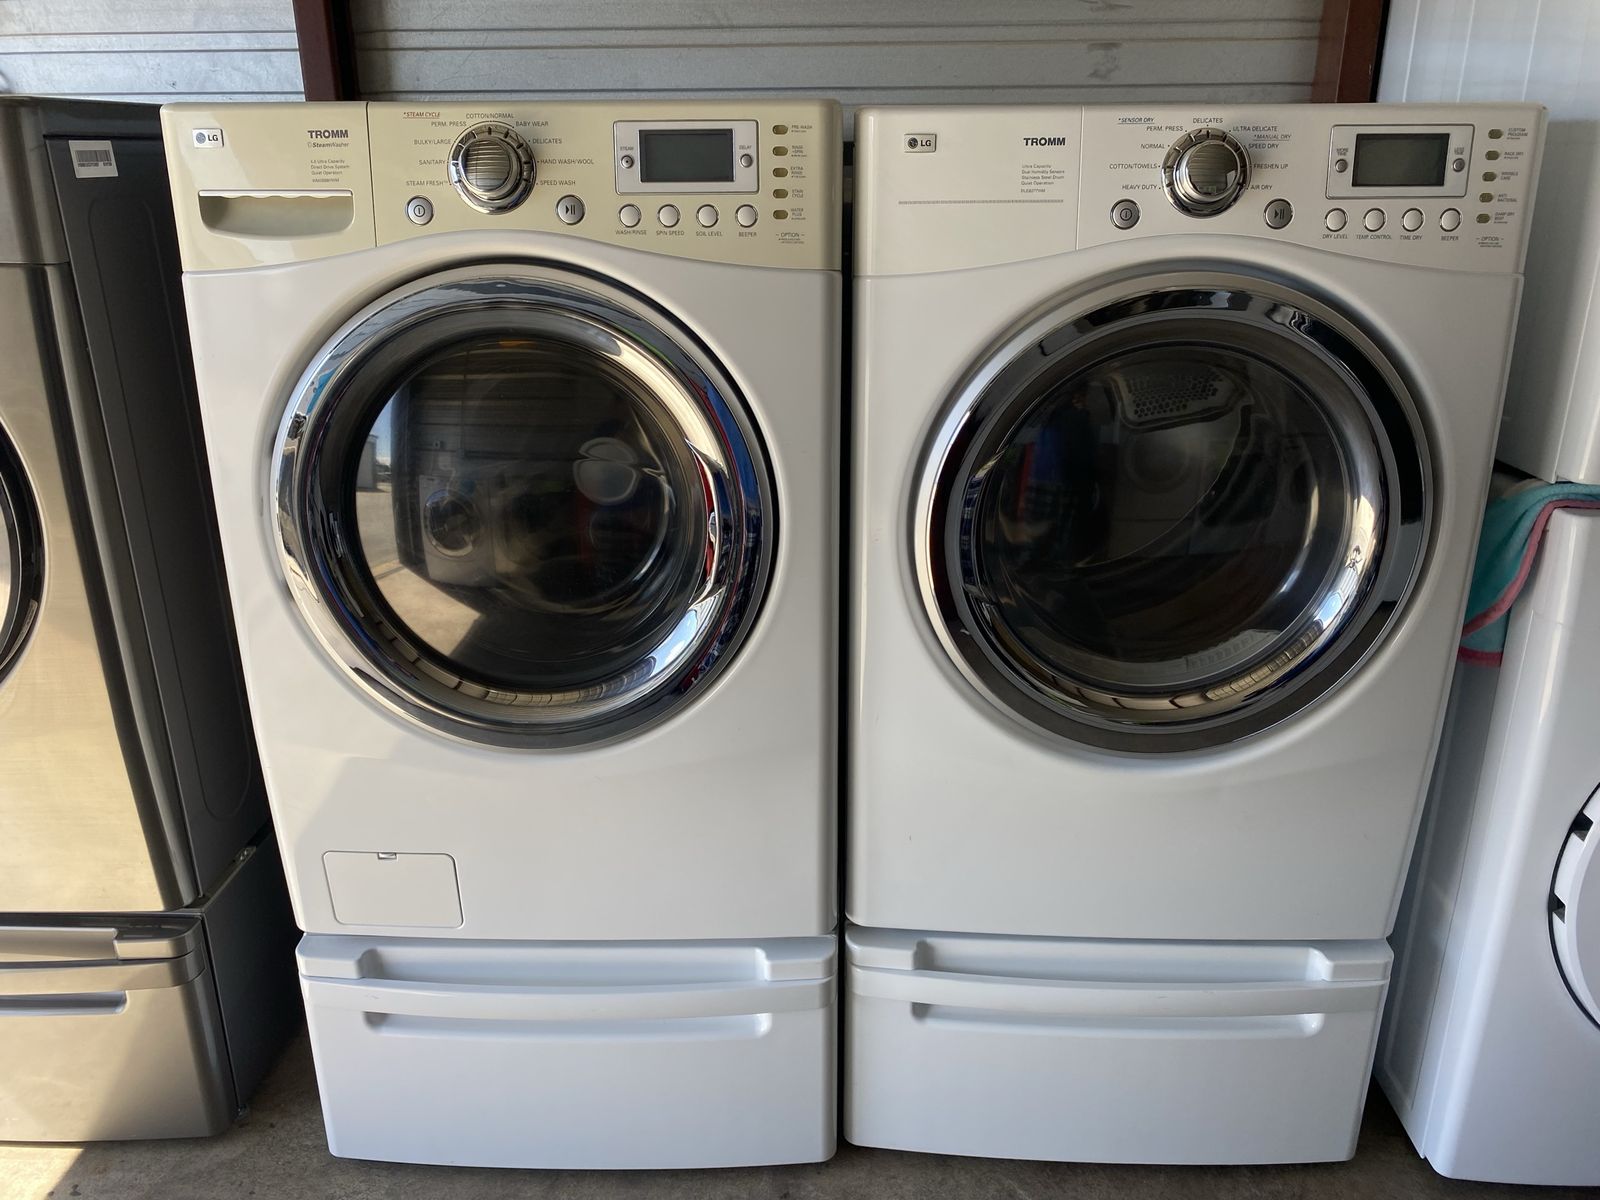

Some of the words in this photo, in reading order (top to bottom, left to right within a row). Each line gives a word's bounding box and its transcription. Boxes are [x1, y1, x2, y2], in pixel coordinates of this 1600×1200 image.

[207, 134, 219, 142] LG
[307, 129, 349, 139] TROMM
[920, 139, 932, 147] LG
[1023, 137, 1066, 146] TROMM
